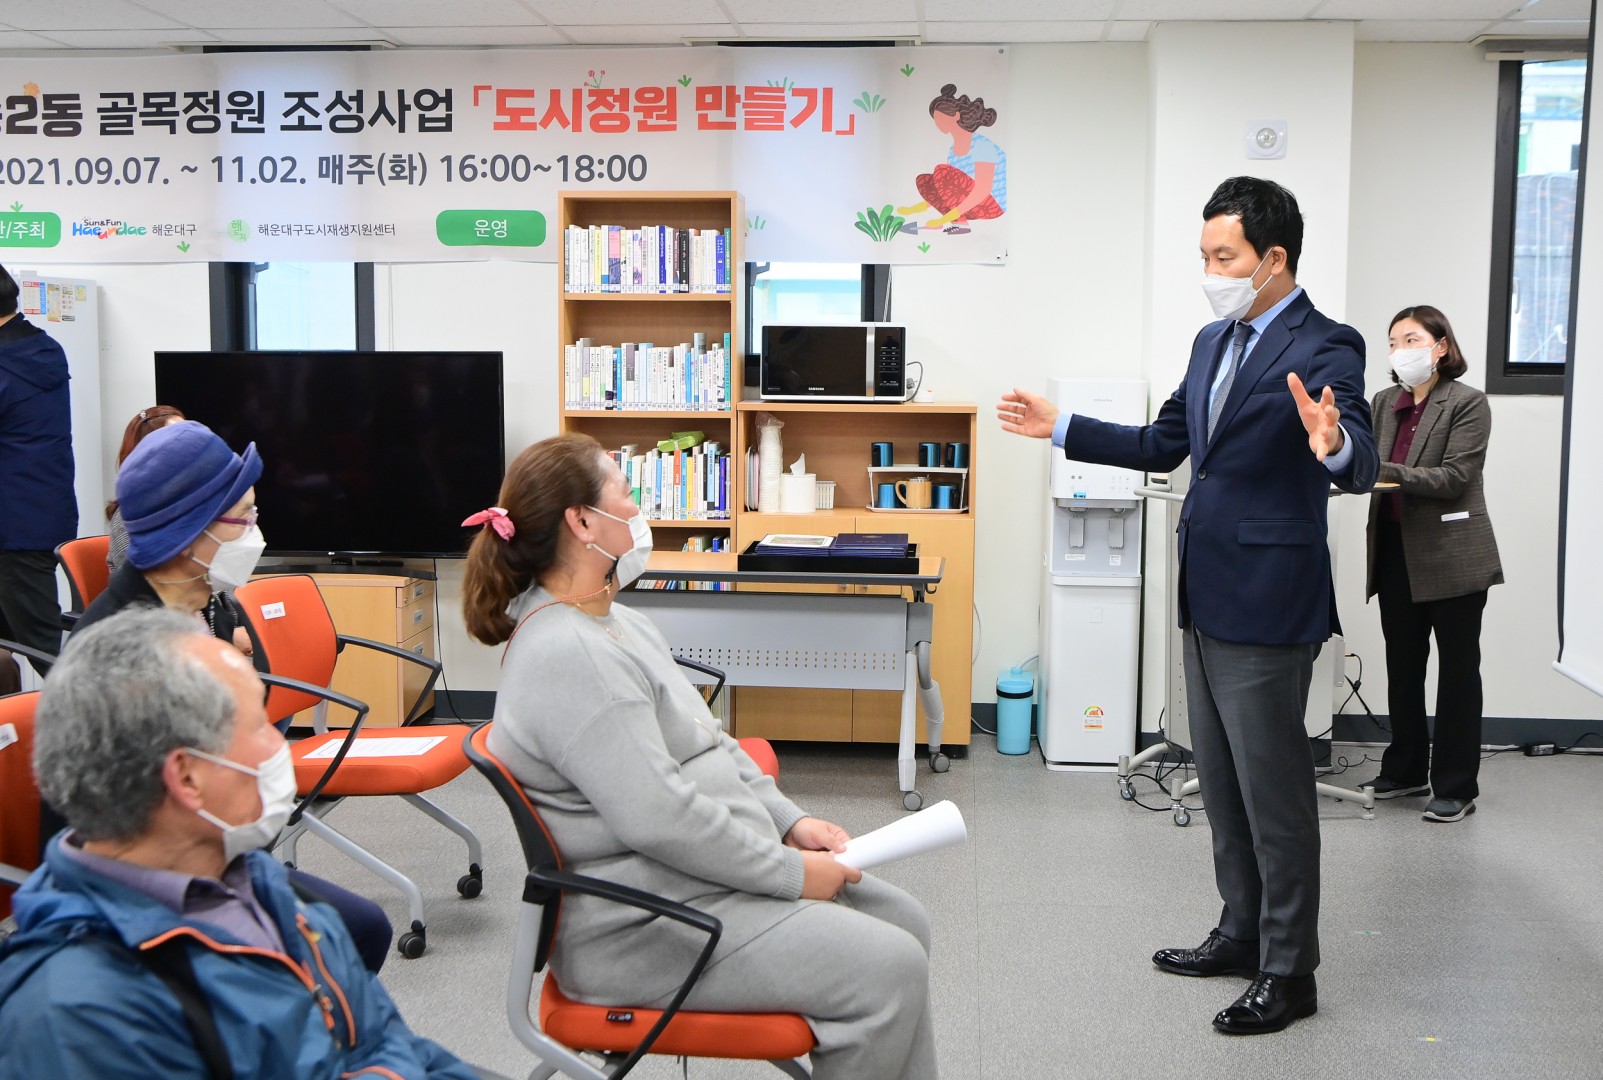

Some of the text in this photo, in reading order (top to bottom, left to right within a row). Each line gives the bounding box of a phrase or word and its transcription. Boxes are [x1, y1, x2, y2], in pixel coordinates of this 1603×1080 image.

[0, 93, 83, 138] 2동
[96, 89, 266, 136] 골목정원
[279, 88, 453, 134] 조성사업
[211, 155, 306, 185] 11.02.
[318, 152, 428, 187] 매주(화)
[440, 153, 648, 183] 16:00~18:00
[151, 223, 197, 237] 해운대구
[257, 223, 396, 237] 해운대구도시재생지원센터
[473, 219, 509, 239] 운영
